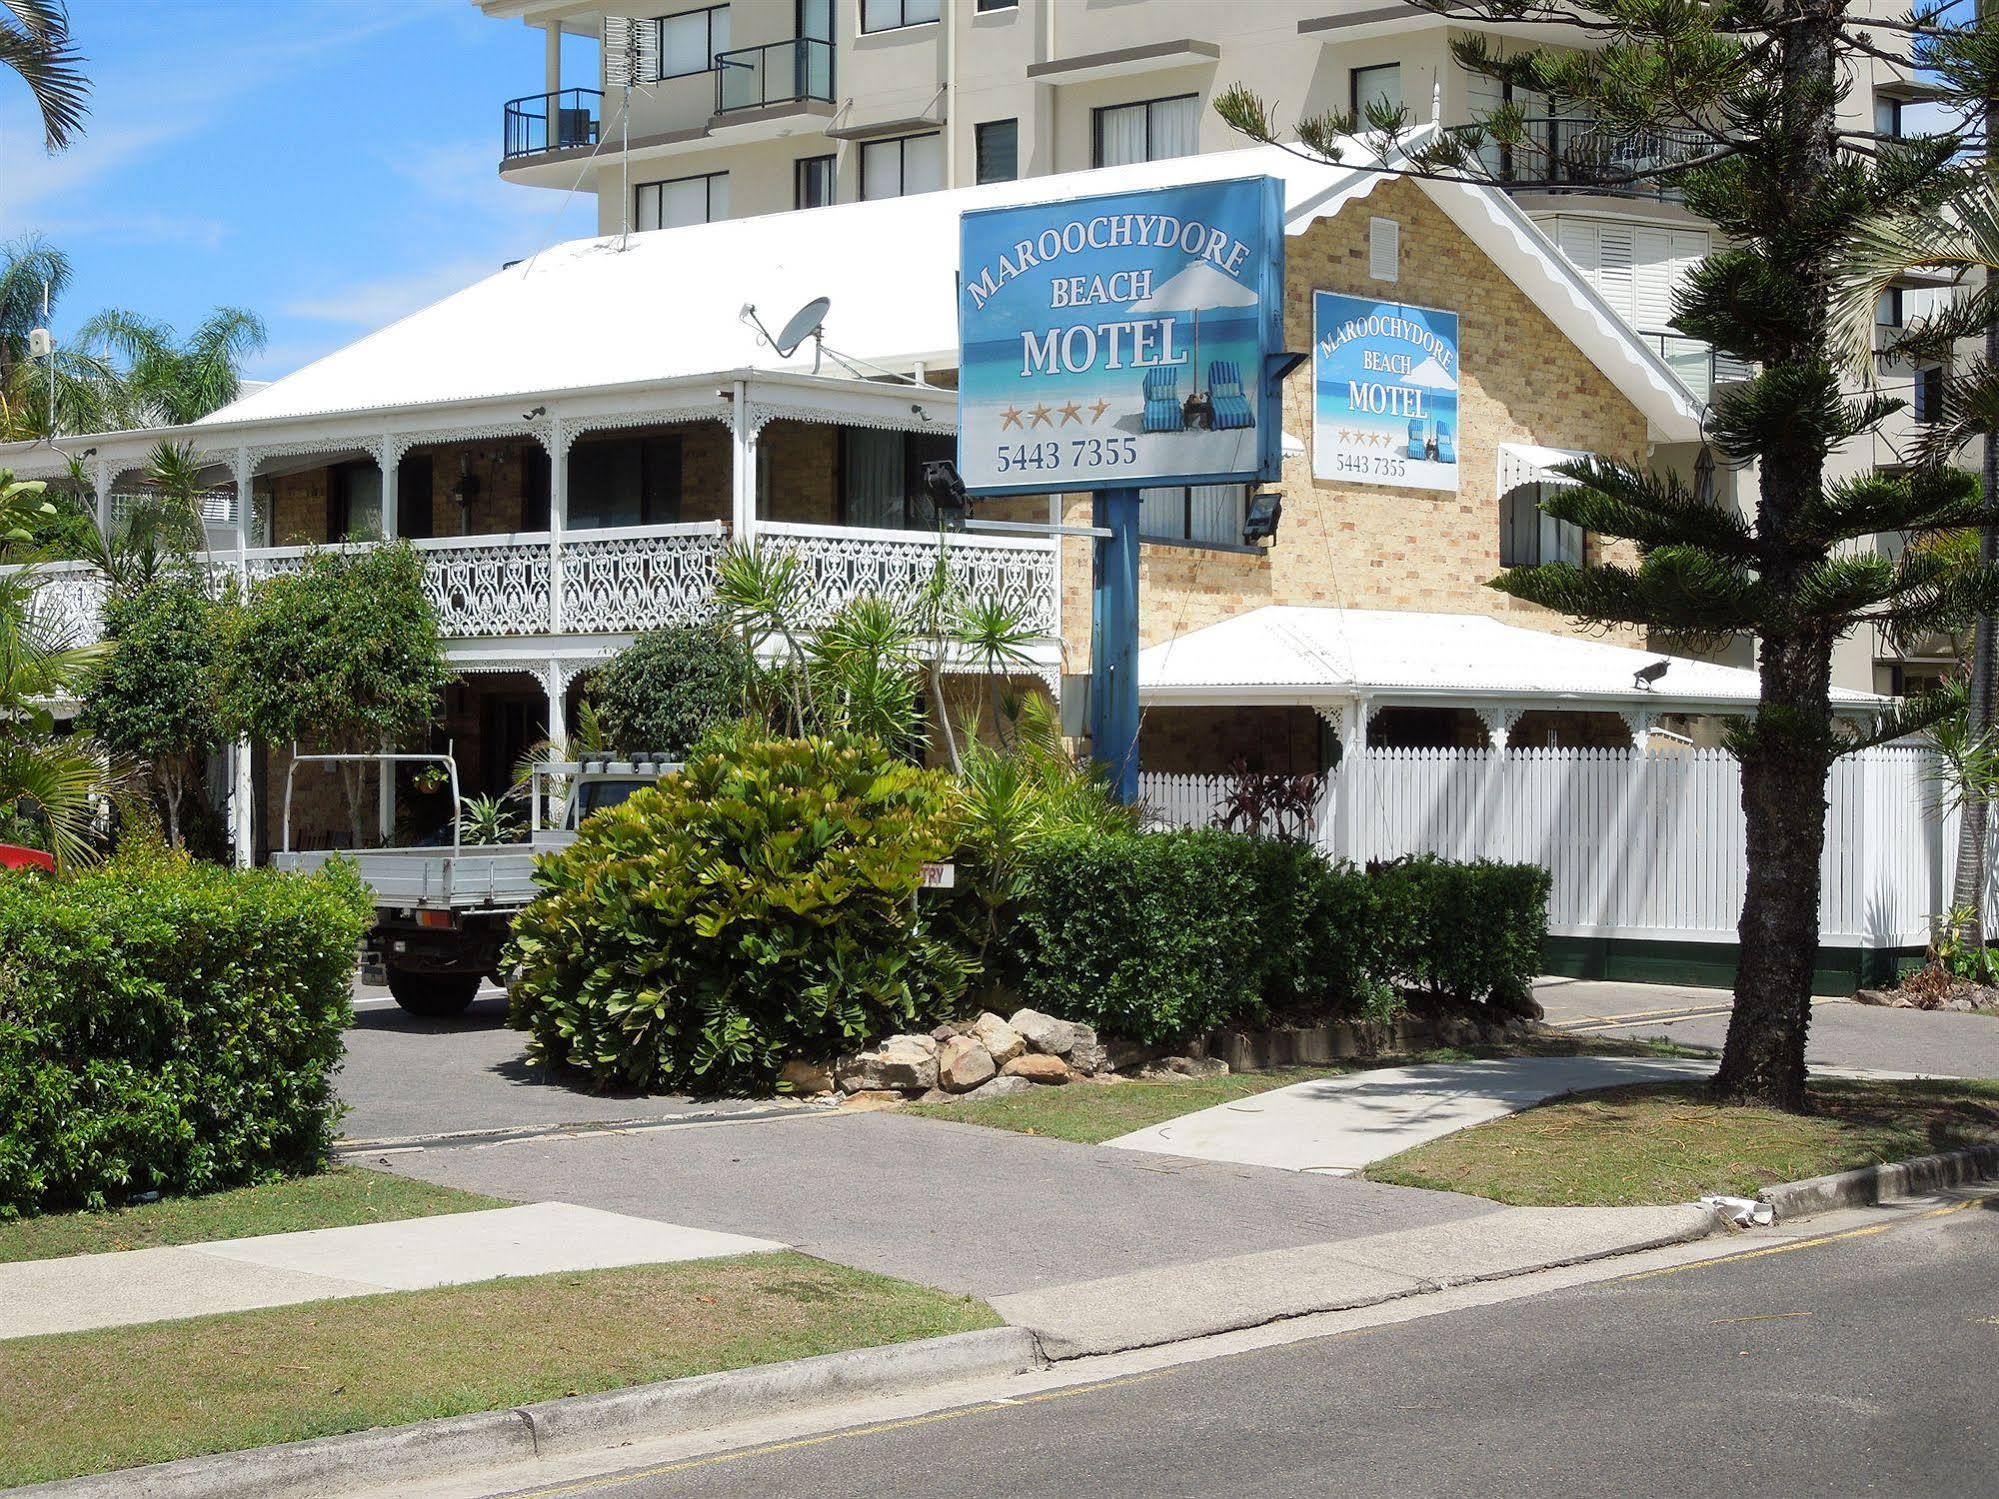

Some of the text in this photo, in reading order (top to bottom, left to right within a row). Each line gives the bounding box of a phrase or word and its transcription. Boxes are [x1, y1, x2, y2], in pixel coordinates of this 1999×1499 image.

[965, 214, 1251, 309] MAROOCHYDORE
[1050, 269, 1153, 308] BEACH
[1020, 317, 1188, 377] MOTEL
[1320, 315, 1453, 371] MAROOCHYDORE
[1363, 350, 1412, 375] BEACH
[1348, 380, 1428, 419] MOTEL
[997, 437, 1137, 472] 5443 7355
[1336, 453, 1405, 477] 5443 7355
